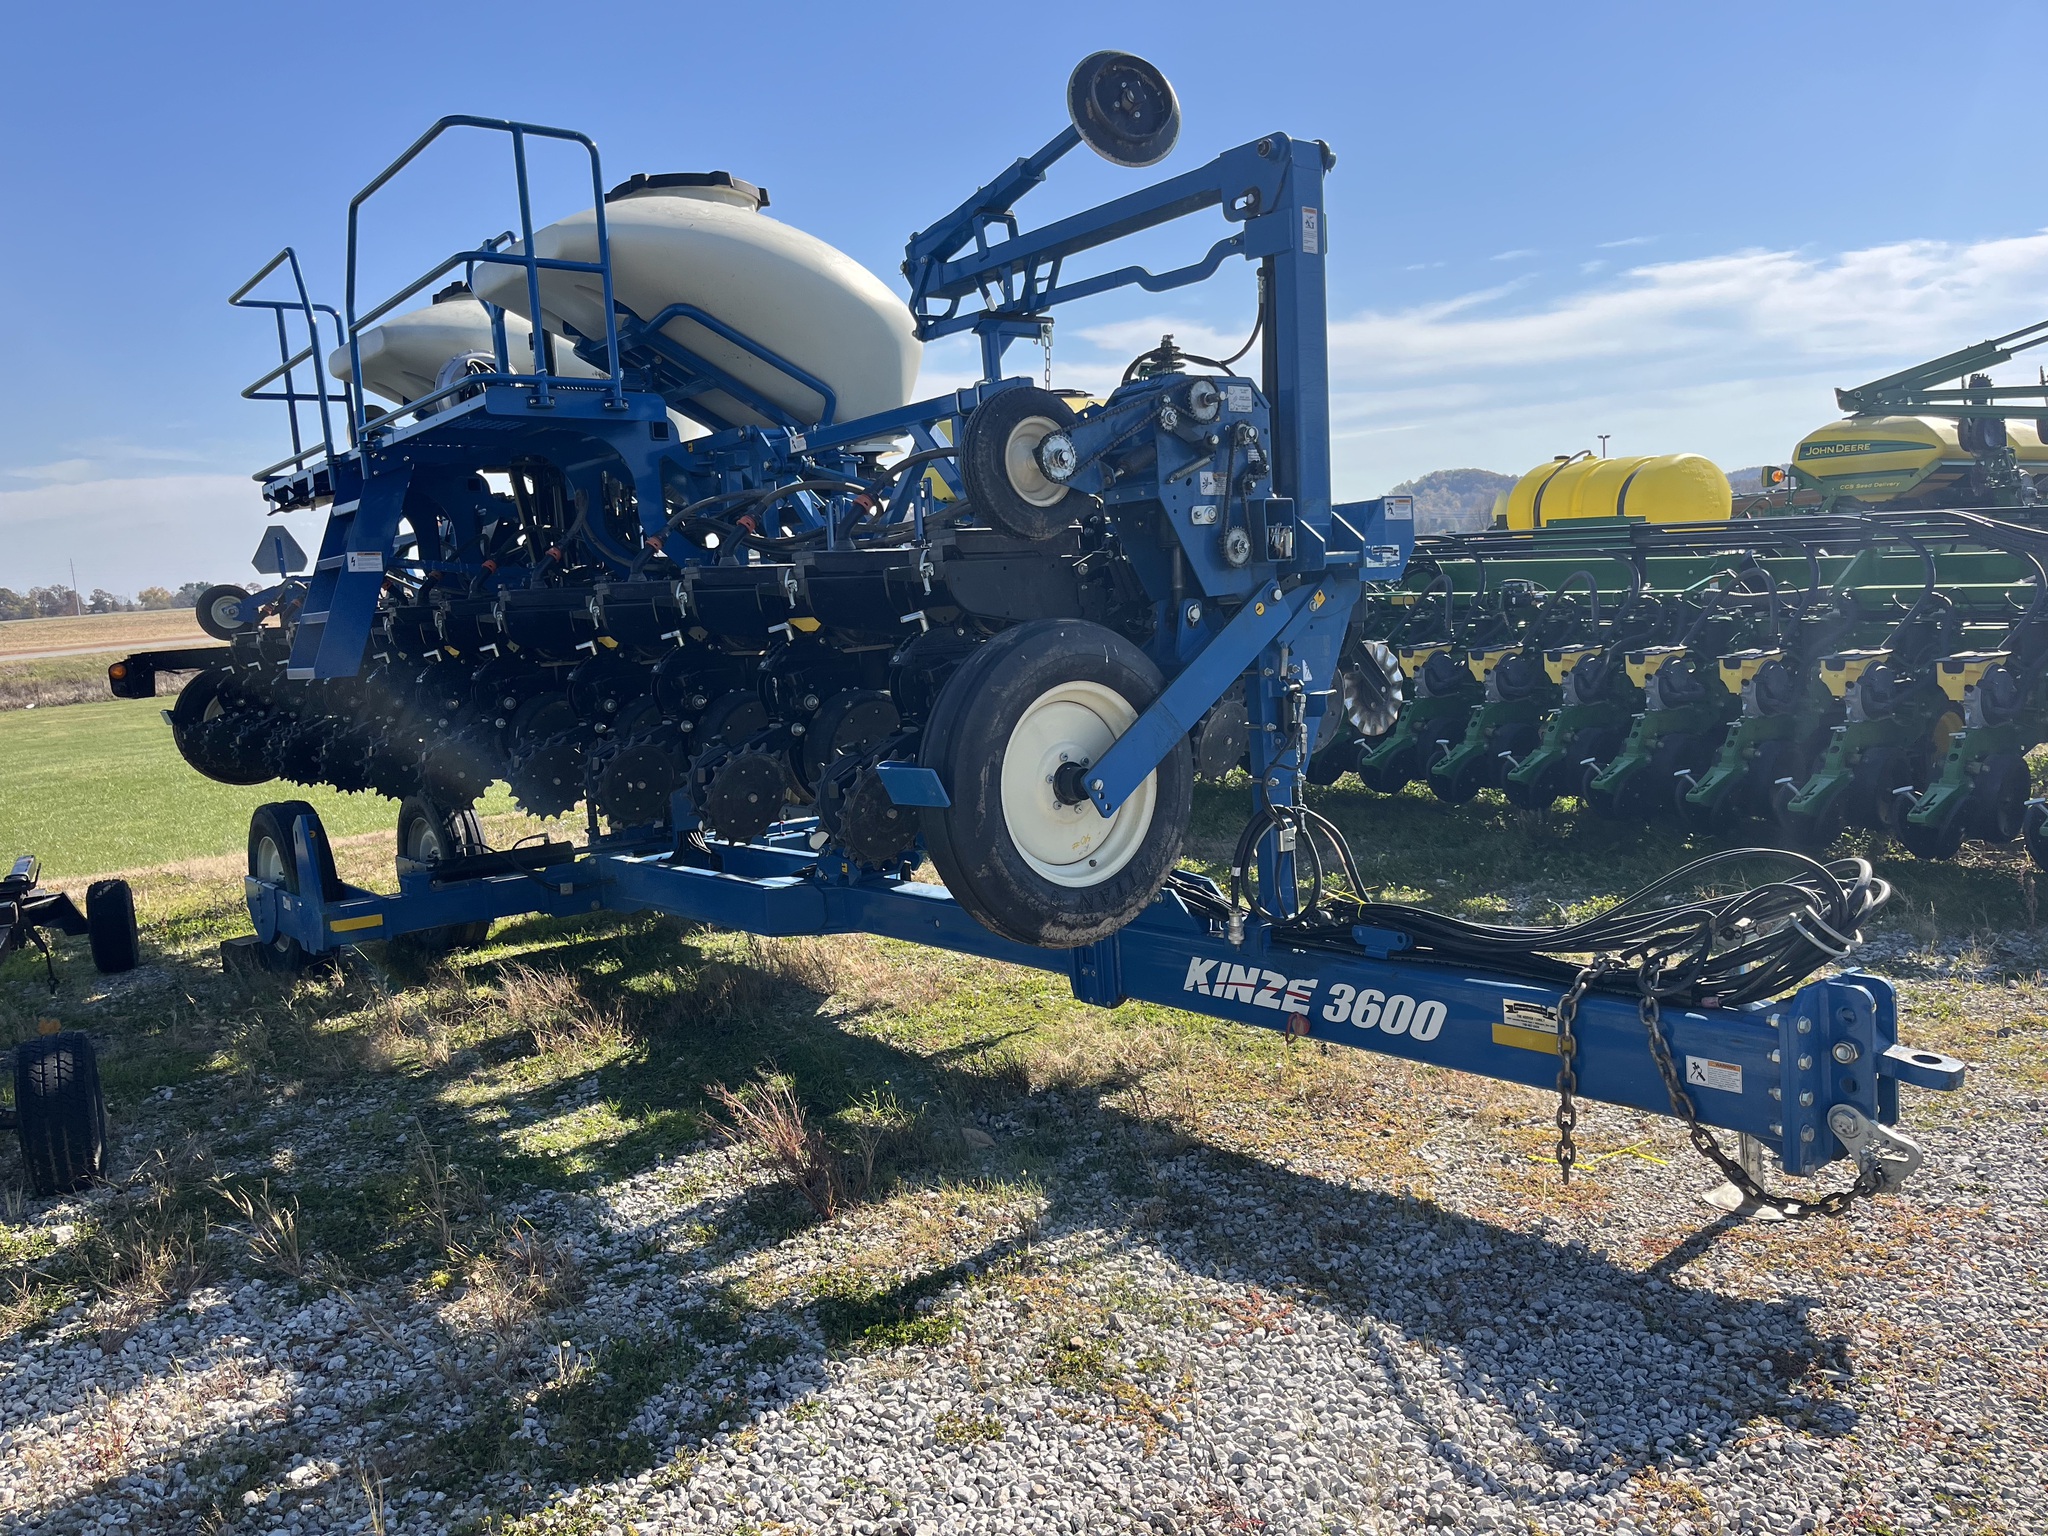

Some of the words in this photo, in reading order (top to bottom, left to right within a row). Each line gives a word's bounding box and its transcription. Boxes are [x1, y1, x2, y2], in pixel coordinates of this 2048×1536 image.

[1806, 446, 1835, 456] JOHN
[1836, 443, 1871, 453] DEERE
[1874, 481, 1900, 489] Delivery
[1183, 956, 1319, 1016] KINZE
[1322, 983, 1448, 1041] 3600
